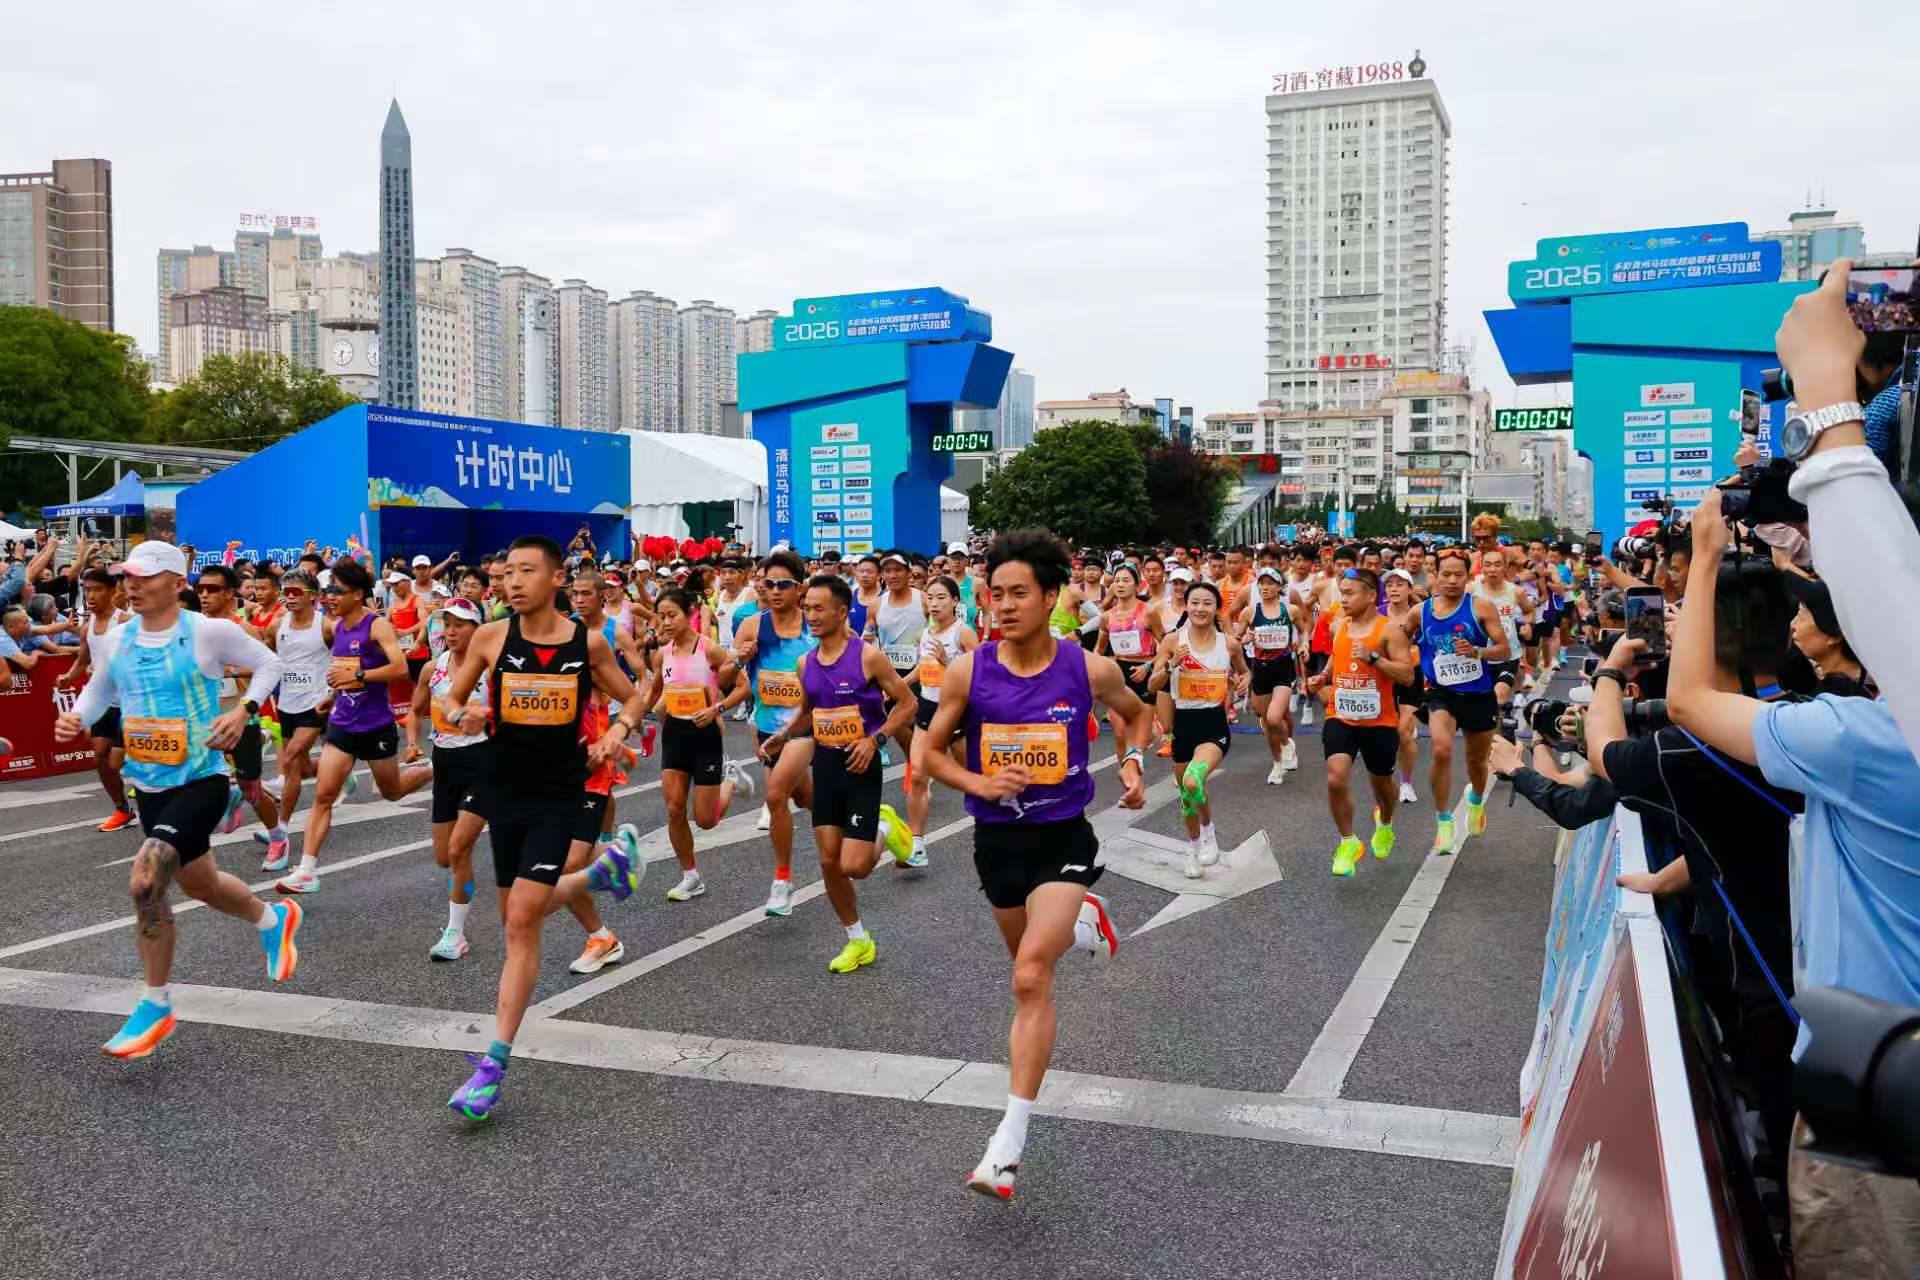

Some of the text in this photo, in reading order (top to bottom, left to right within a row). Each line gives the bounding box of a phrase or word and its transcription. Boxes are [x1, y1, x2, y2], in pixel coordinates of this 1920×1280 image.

[1525, 265, 1601, 289] 2026
[785, 321, 839, 341] 2026
[1500, 410, 1572, 429] 0:00:04
[933, 434, 989, 451] 0:00:04
[455, 439, 573, 494] 计时中心
[1440, 663, 1478, 678] A10128
[283, 676, 312, 684] A10561
[762, 686, 800, 697] A50026
[508, 696, 569, 710] A50013
[1339, 703, 1376, 712] A10055
[818, 724, 857, 736] A50010
[128, 738, 178, 751] A50283
[989, 752, 1058, 767] A50008
